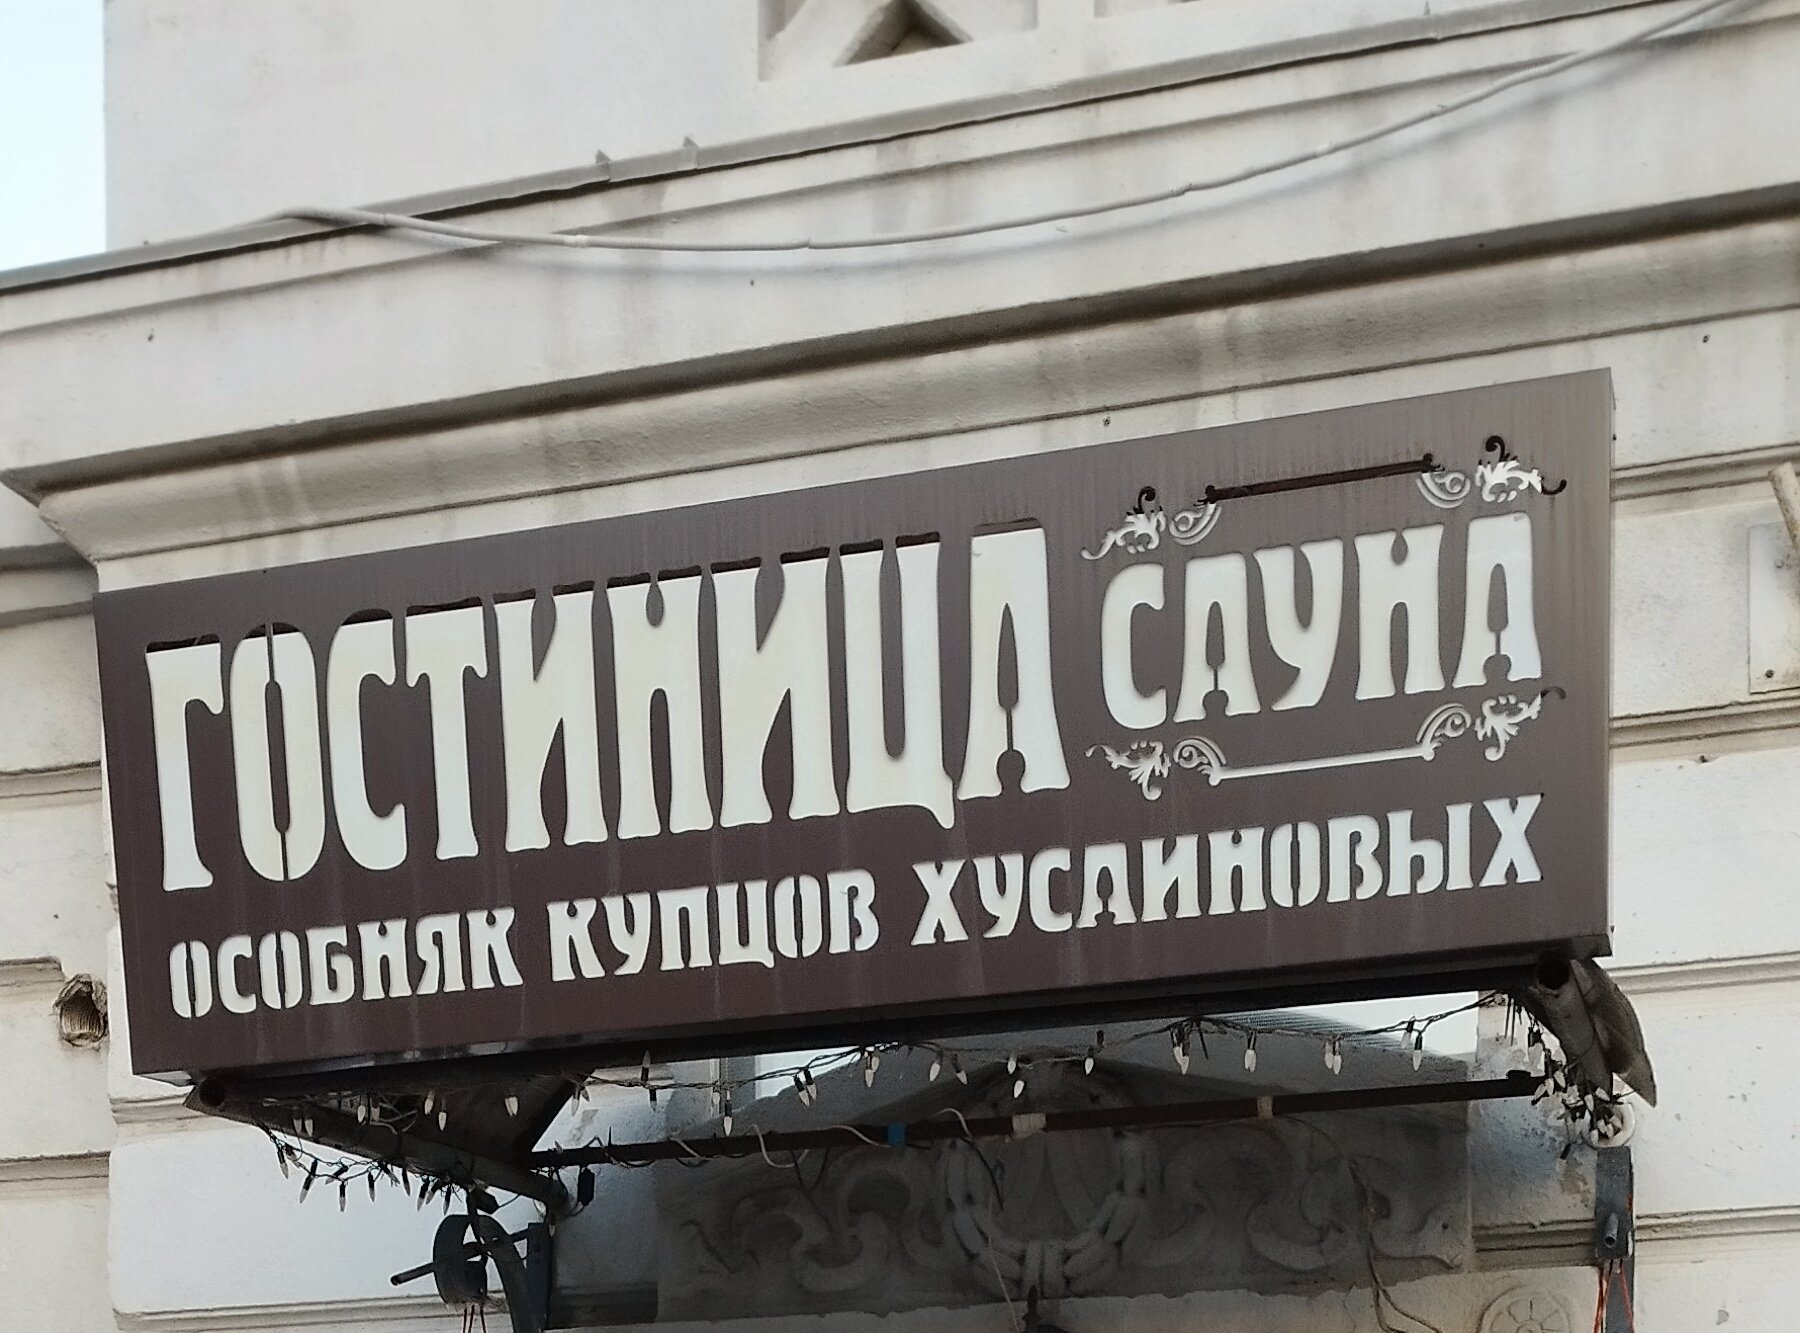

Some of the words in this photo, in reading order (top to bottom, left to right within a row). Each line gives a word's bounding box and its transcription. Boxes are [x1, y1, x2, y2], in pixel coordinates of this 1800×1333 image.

[145, 520, 1071, 893] ГОСТИНИЦА
[1100, 511, 1543, 730] САУНА
[168, 907, 525, 1019] ОСОБНЯК
[546, 869, 881, 983] КУПЦОВ
[910, 793, 1543, 947] ХУСАИНОВЫХ
